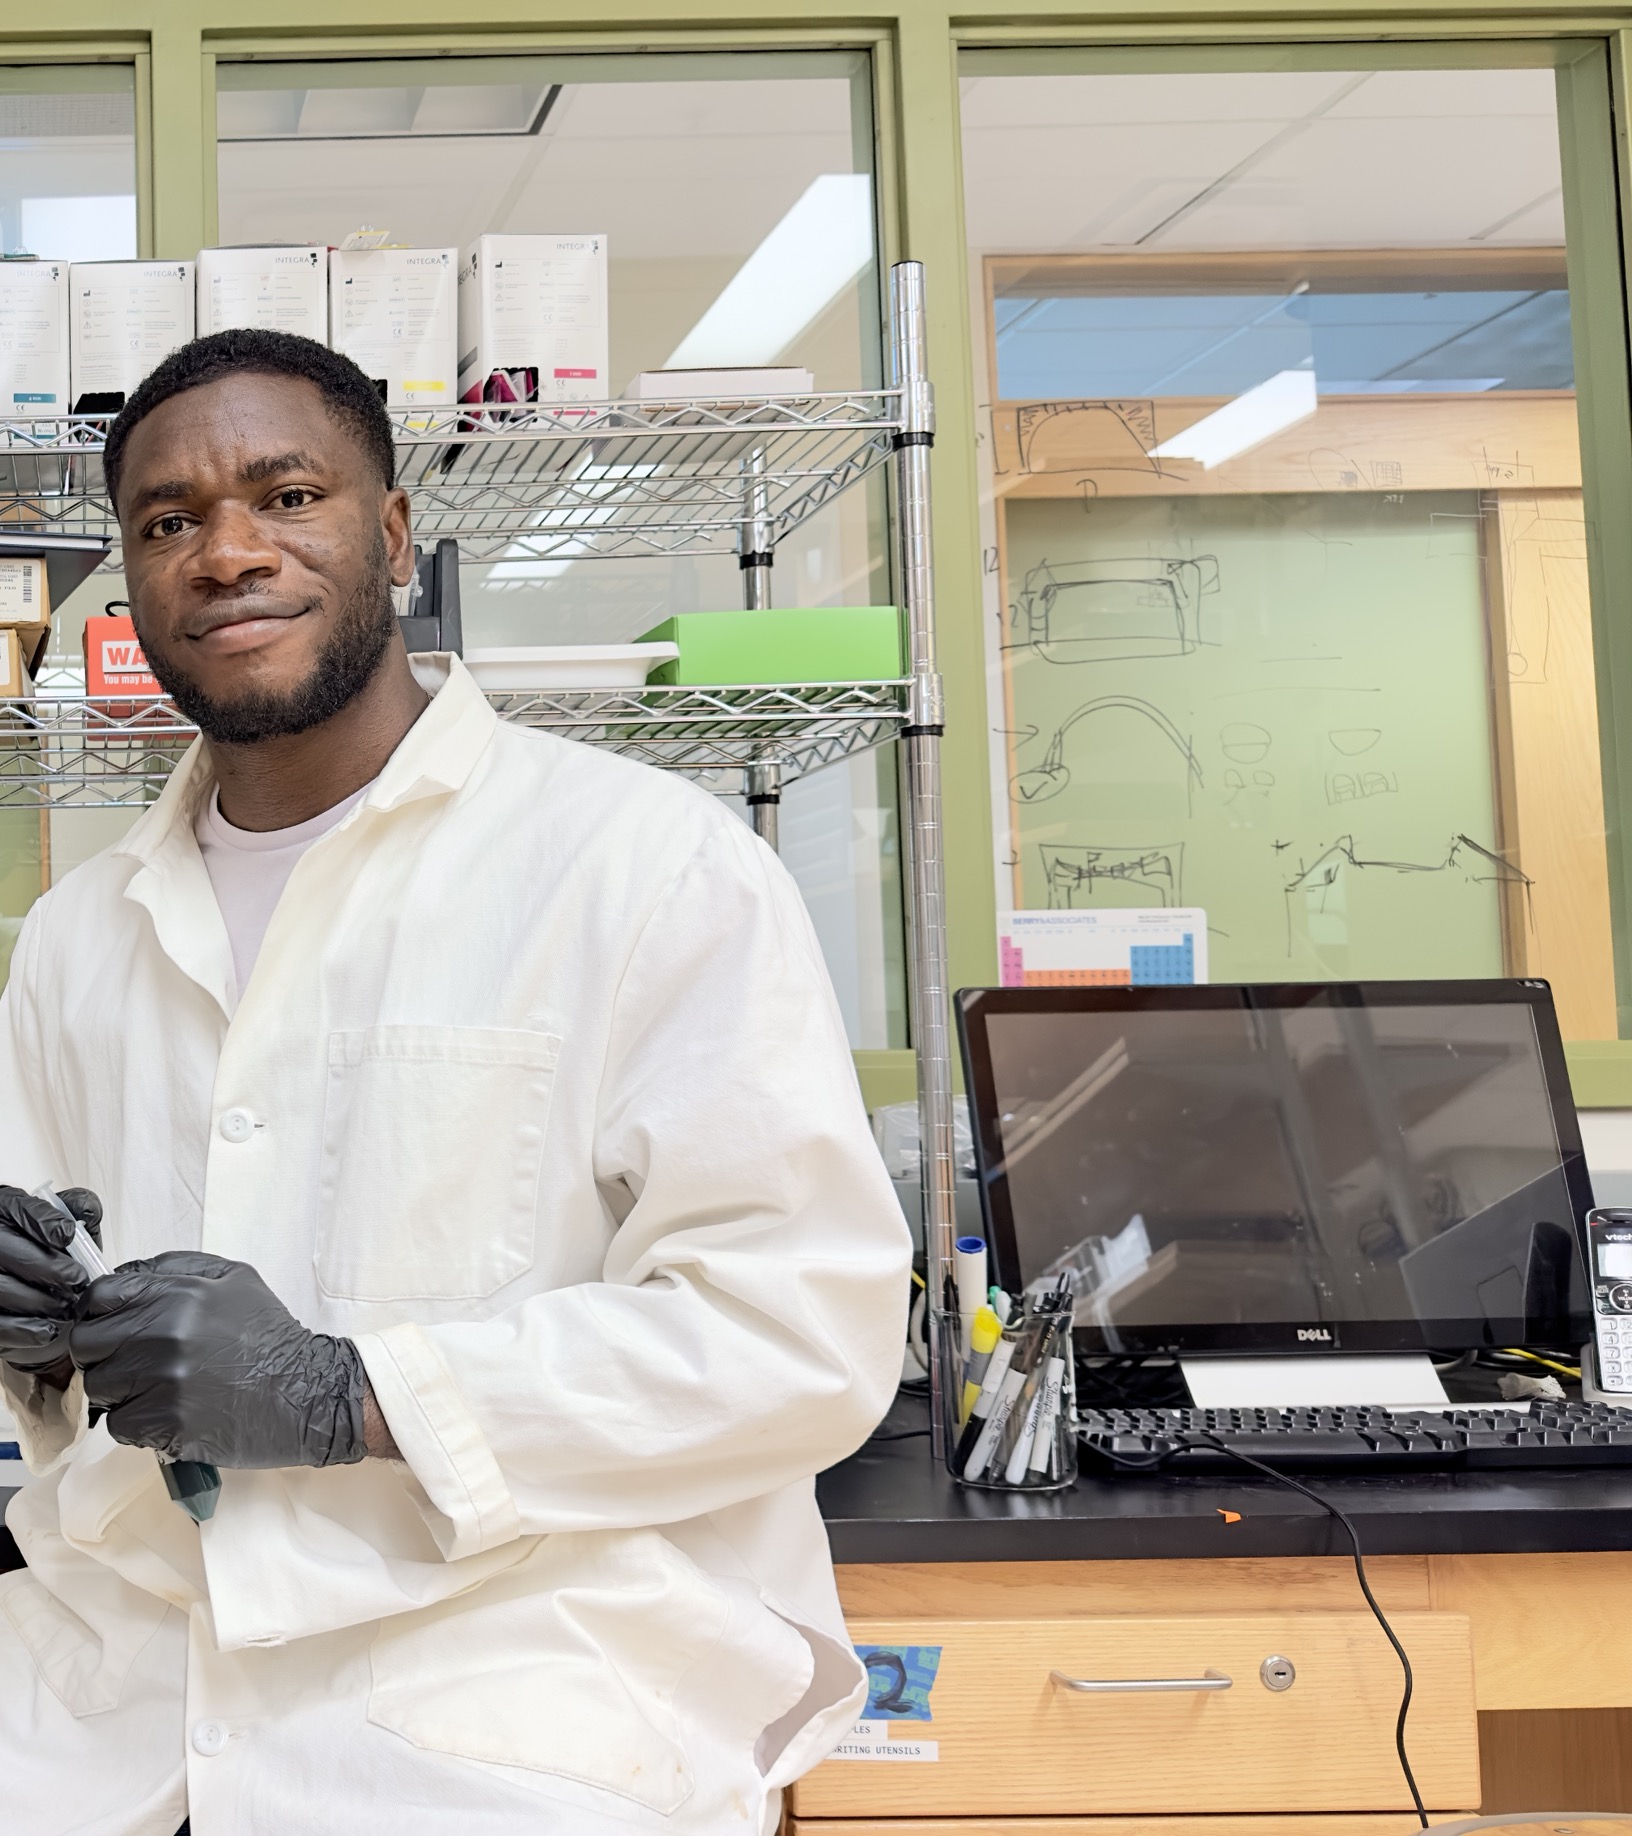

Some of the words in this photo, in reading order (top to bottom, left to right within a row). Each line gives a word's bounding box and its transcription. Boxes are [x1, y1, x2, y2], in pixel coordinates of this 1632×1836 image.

[104, 674, 119, 684] You
[122, 675, 140, 685] may
[142, 674, 152, 684] be
[1297, 1329, 1332, 1341] DELL
[995, 1394, 1015, 1431] Sharpie
[876, 1746, 921, 1755] UTENSILS
